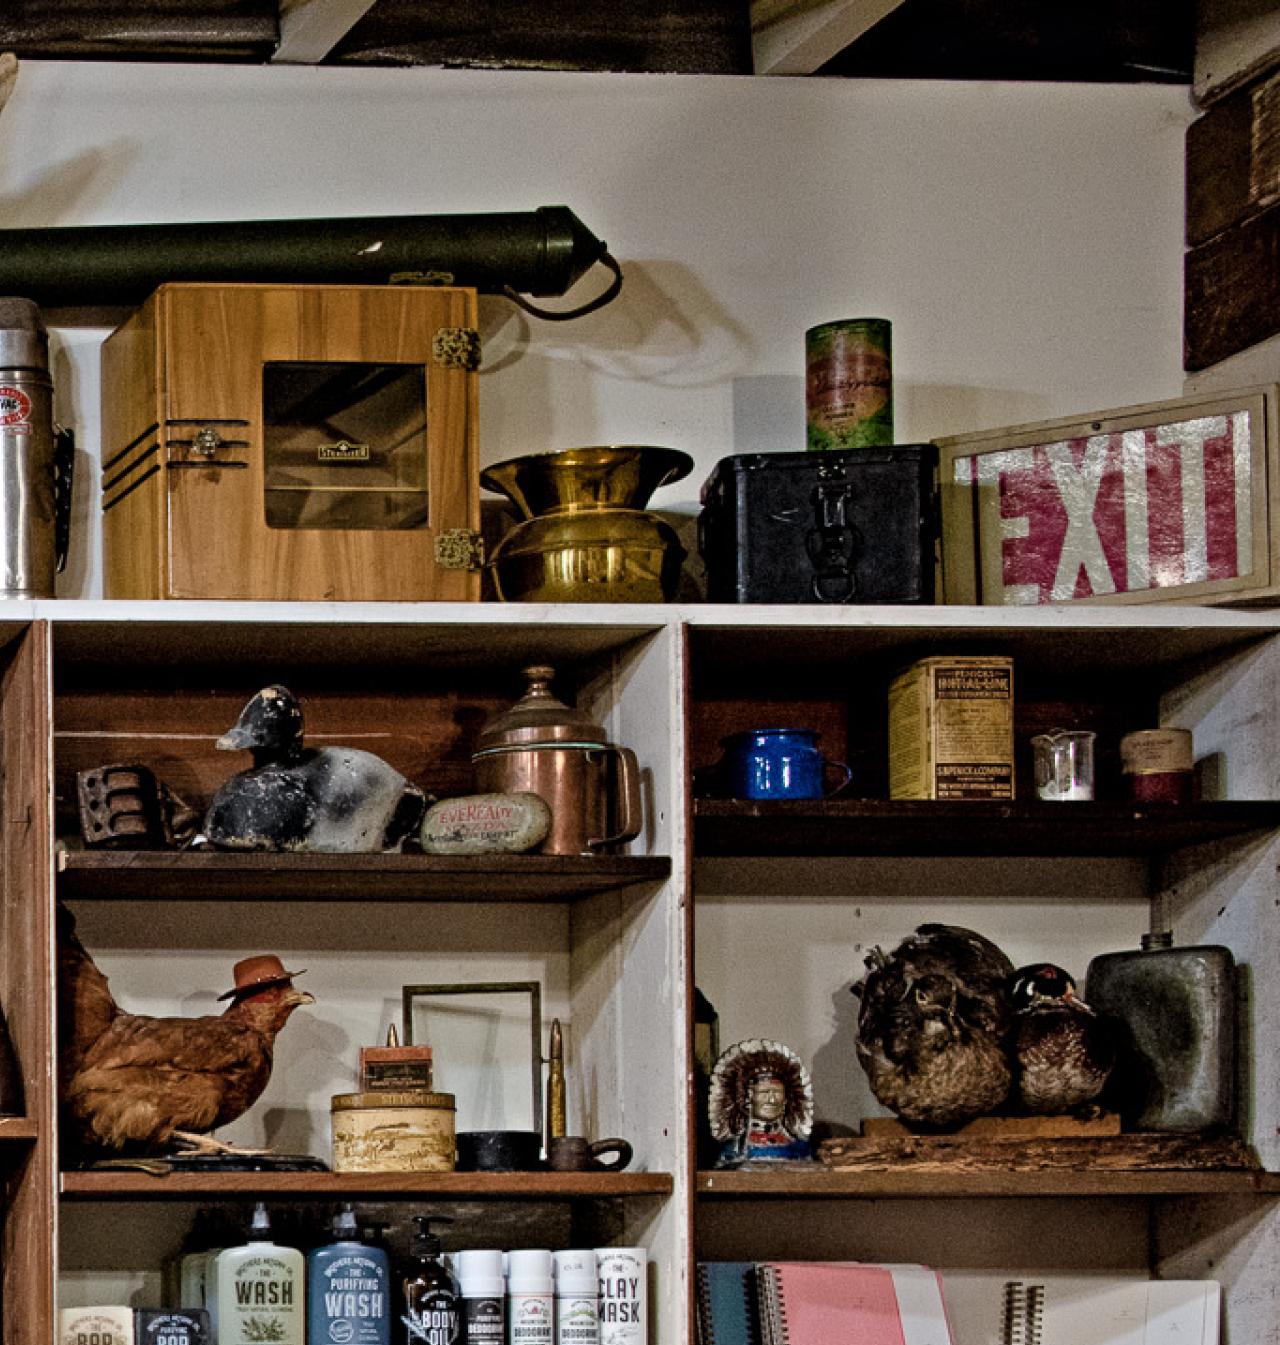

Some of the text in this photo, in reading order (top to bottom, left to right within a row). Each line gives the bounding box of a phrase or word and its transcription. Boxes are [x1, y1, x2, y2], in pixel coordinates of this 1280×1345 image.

[979, 414, 1228, 604] EXIT
[440, 803, 514, 824] EVEREADY
[349, 1268, 362, 1278] THE
[235, 1280, 293, 1305] WASH
[330, 1278, 379, 1291] PURIFYING
[325, 1292, 384, 1319] WASH
[422, 1310, 456, 1328] BODY
